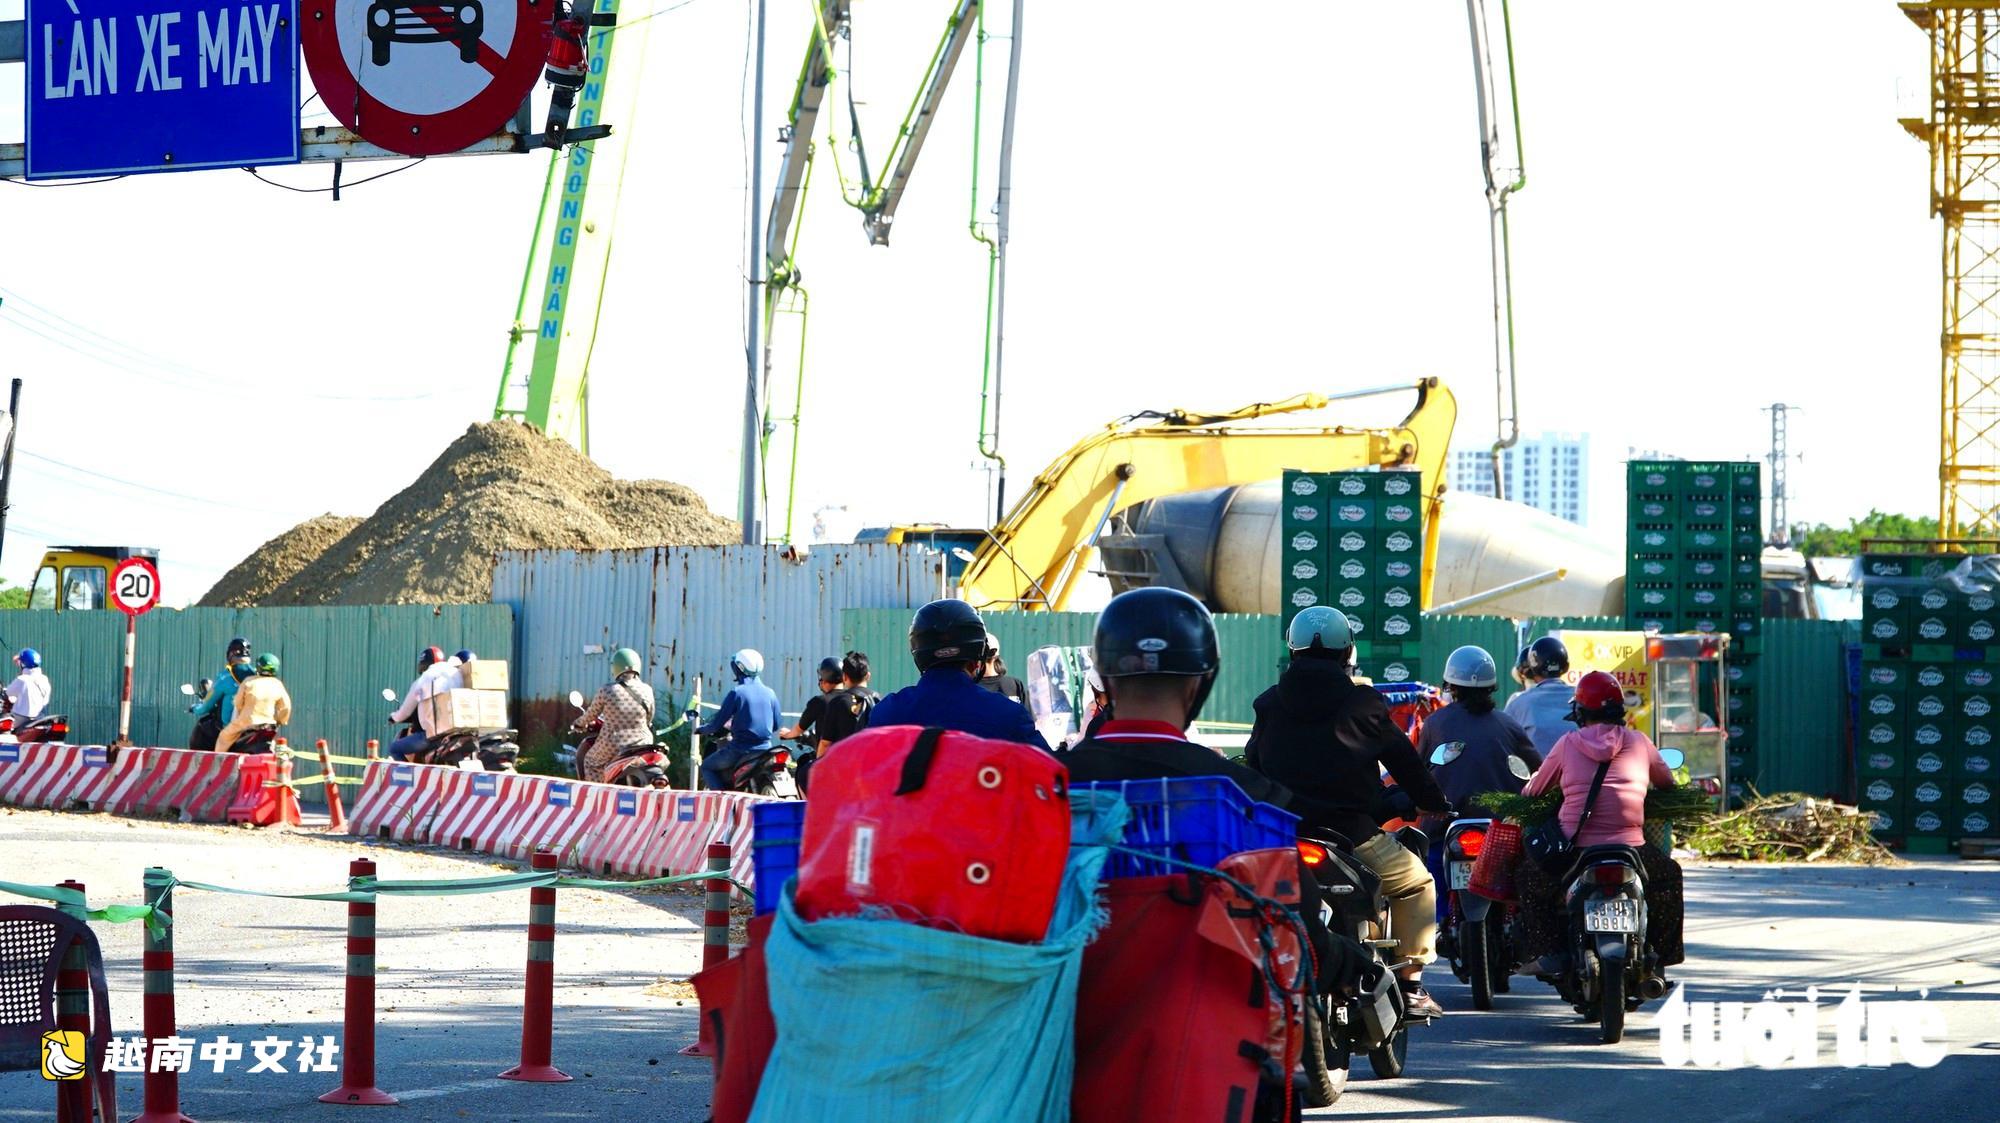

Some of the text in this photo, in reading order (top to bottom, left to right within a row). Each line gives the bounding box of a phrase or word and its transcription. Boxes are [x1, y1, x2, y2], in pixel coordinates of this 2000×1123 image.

[44, 0, 117, 99] LÀN
[135, 12, 182, 92] XE
[559, 146, 587, 246] SÔNG
[121, 573, 150, 598] 20
